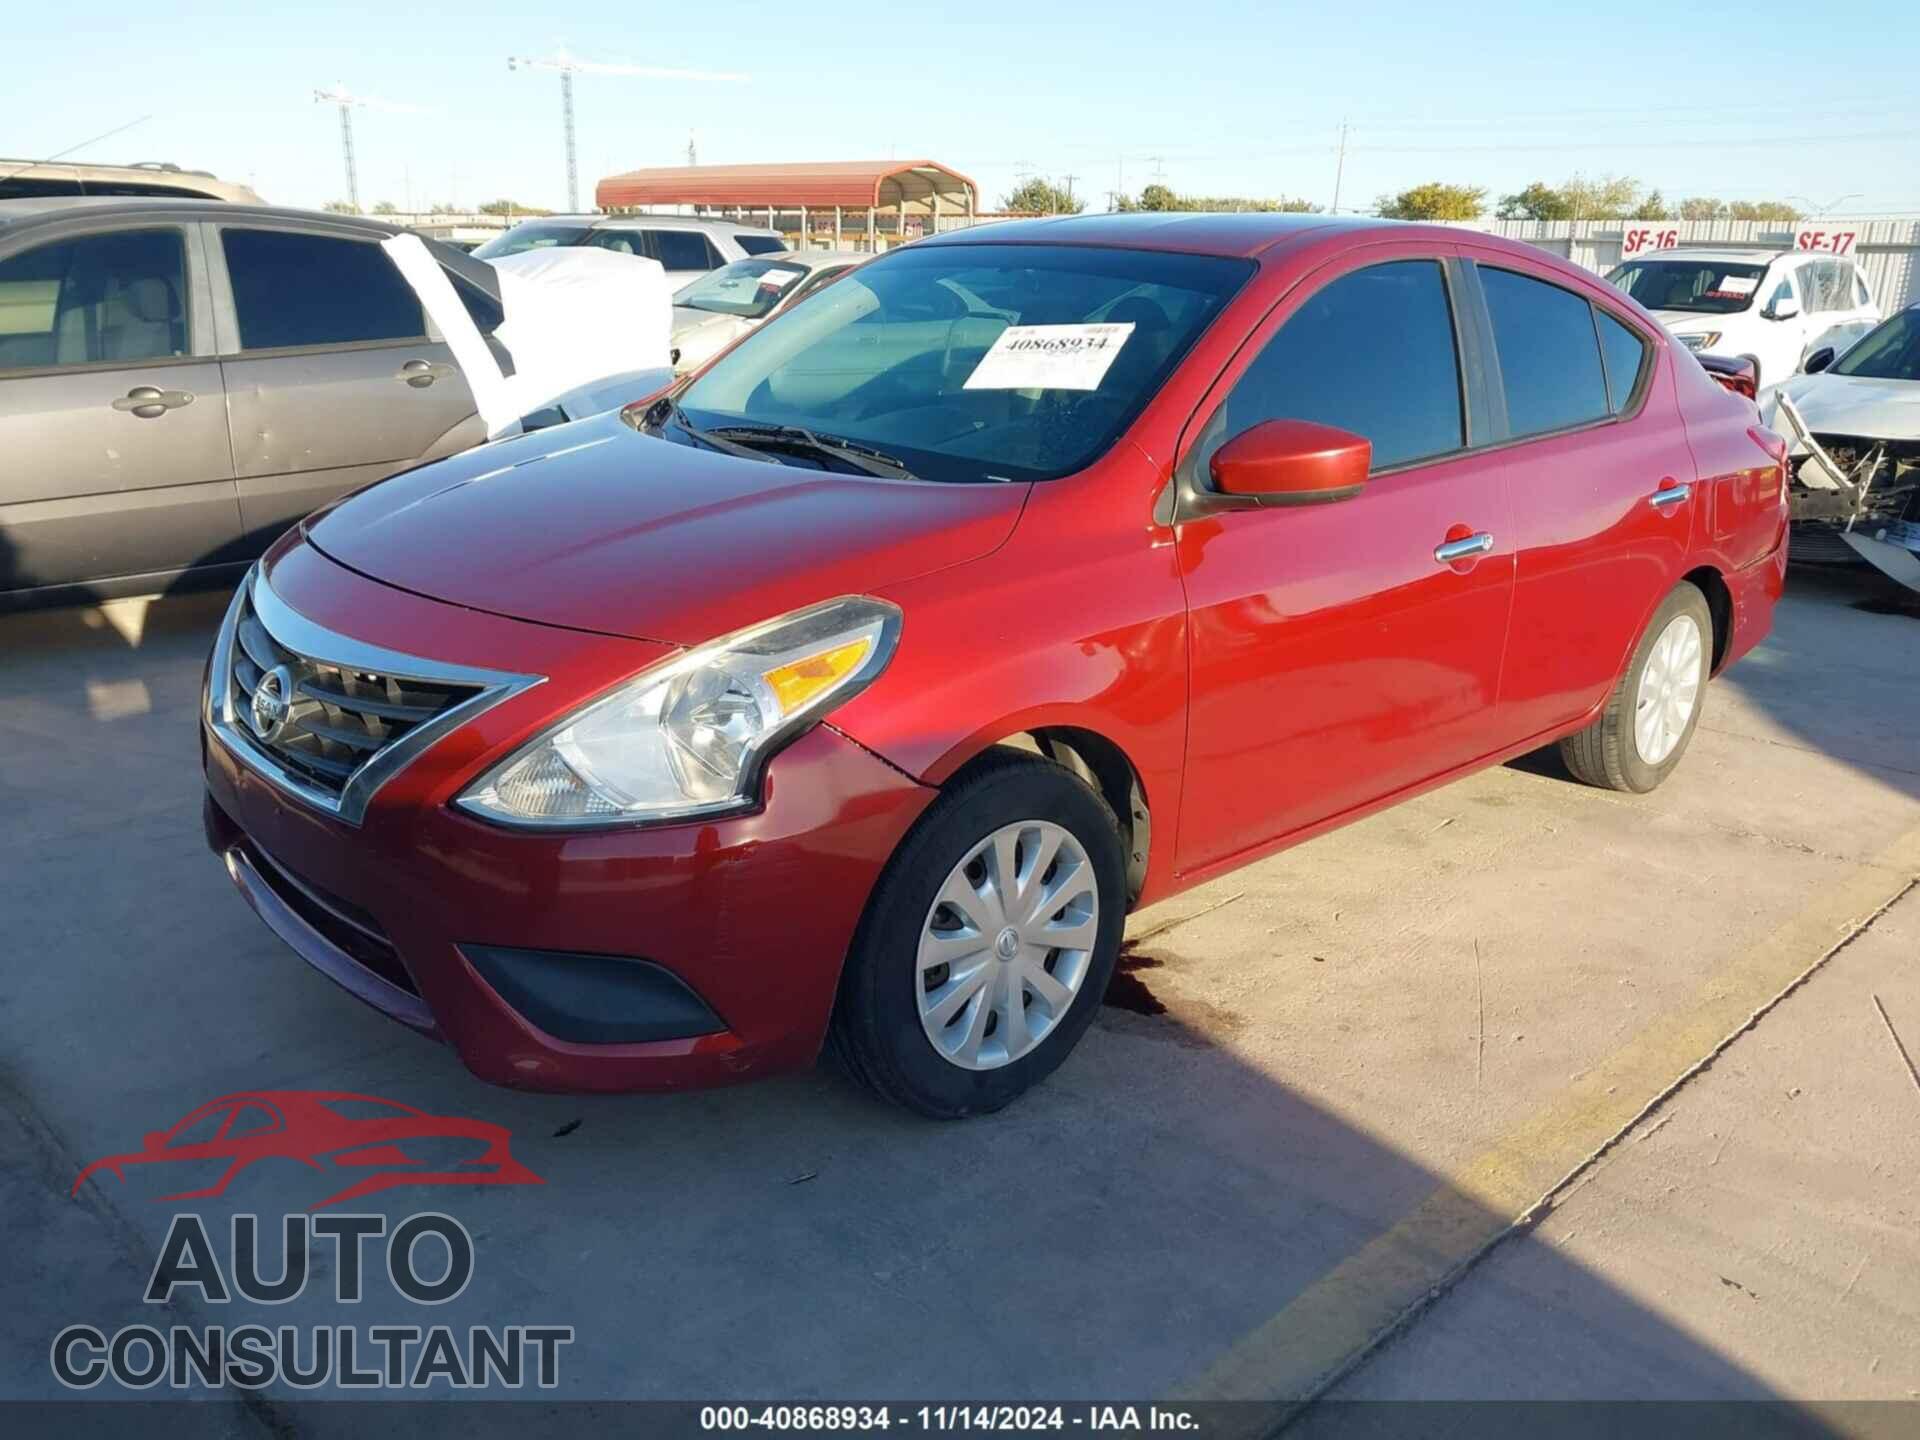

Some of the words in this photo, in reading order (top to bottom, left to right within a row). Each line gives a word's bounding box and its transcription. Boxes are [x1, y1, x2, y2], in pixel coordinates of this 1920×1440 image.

[1624, 229, 1678, 252] SF-16
[1798, 231, 1856, 255] SF-17
[1006, 337, 1108, 351] 40868934
